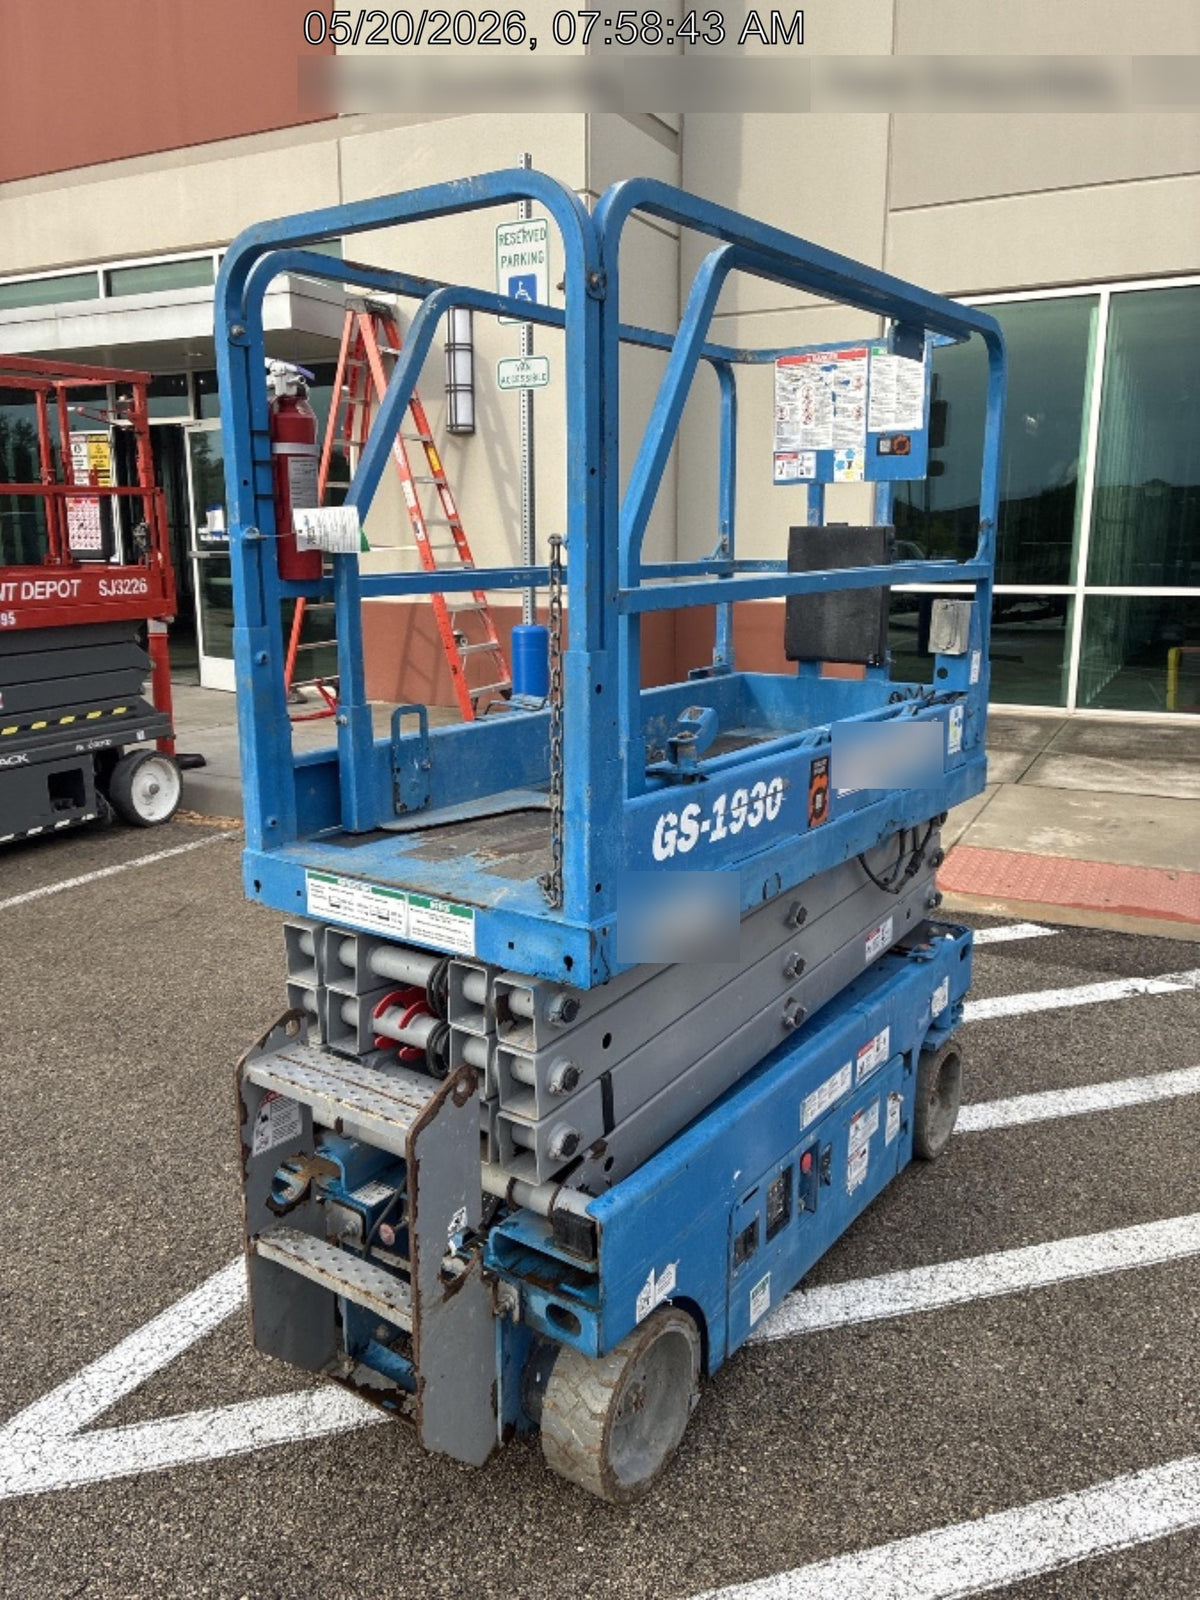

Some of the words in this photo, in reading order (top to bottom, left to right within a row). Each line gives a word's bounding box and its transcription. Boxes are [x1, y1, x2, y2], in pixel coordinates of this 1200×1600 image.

[499, 227, 547, 247] RESERVED
[500, 250, 545, 268] PARKING
[21, 579, 82, 600] DEPOT
[98, 577, 148, 597] SJ3226
[652, 776, 785, 862] GS-1930
